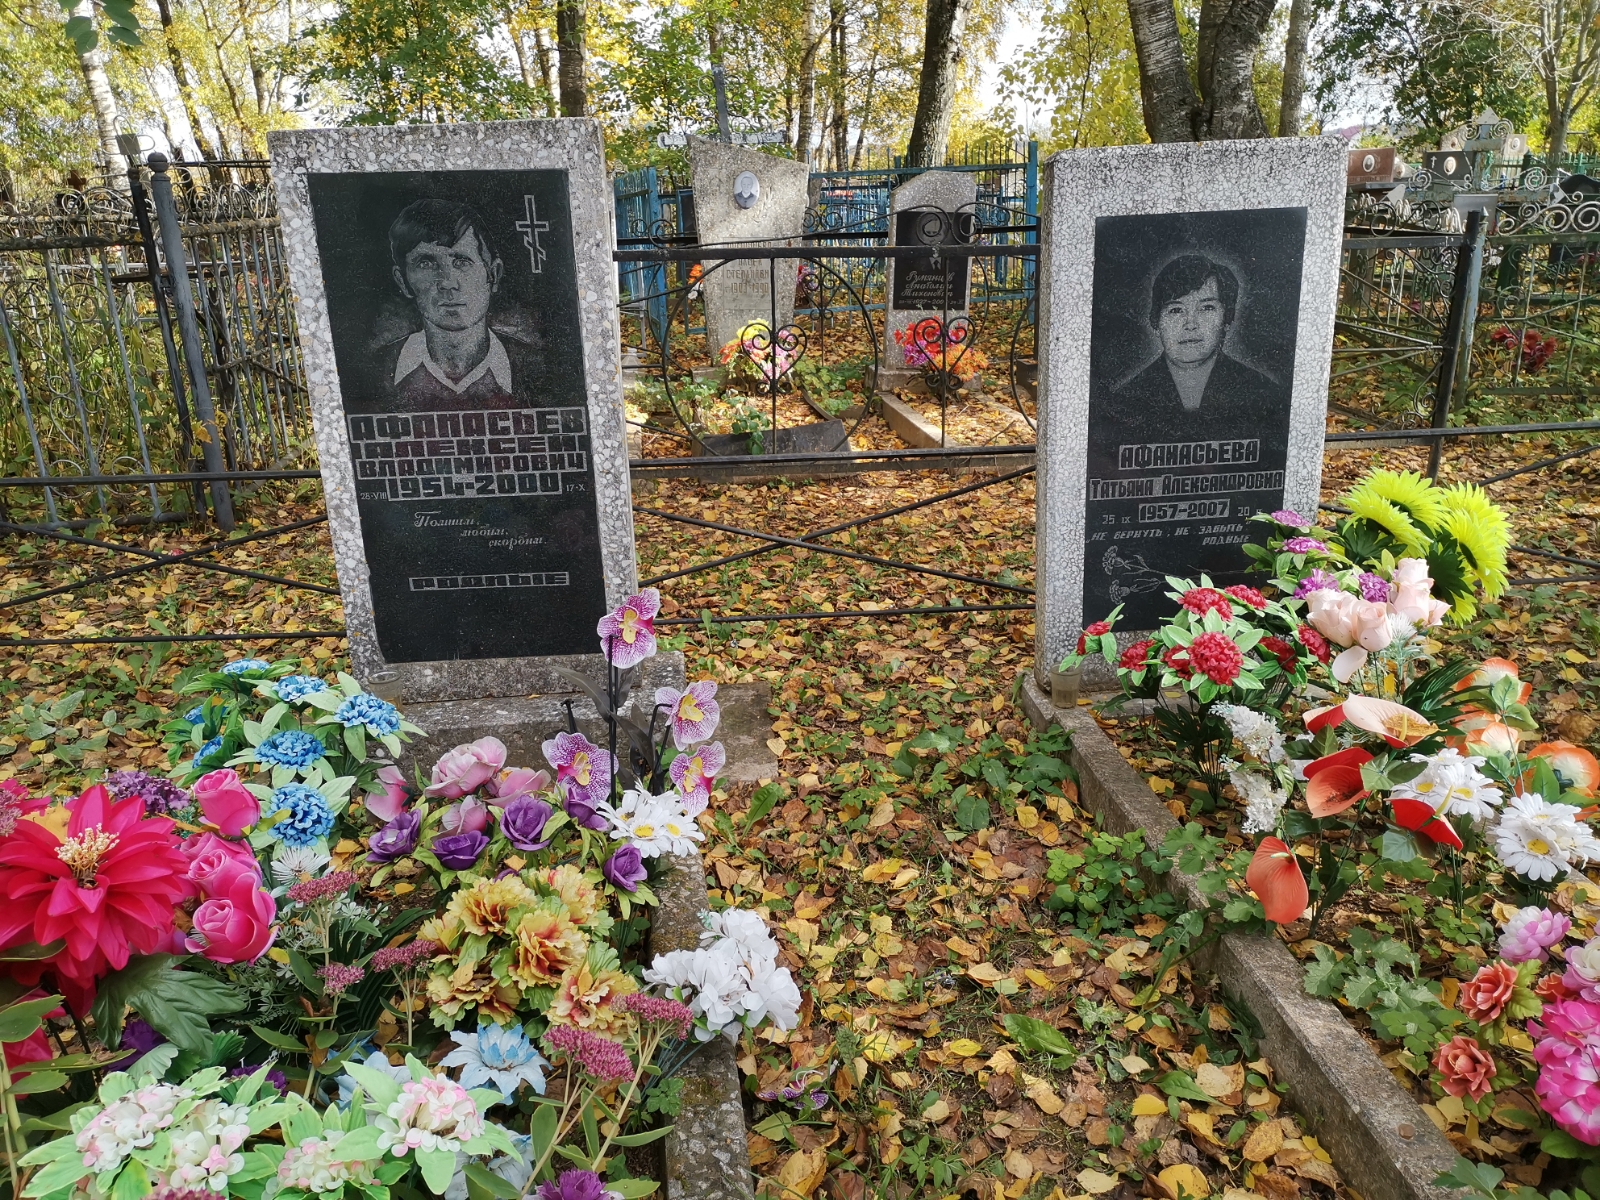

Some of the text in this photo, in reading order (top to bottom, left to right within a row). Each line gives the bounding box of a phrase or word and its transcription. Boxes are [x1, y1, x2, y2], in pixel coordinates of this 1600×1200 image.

[357, 452, 586, 479] ВЛАДИМИРОВИЧ
[1119, 440, 1259, 470] АФАНАСЬЕВА
[1139, 499, 1230, 523] 1957-2007
[1237, 506, 1250, 517] 20
